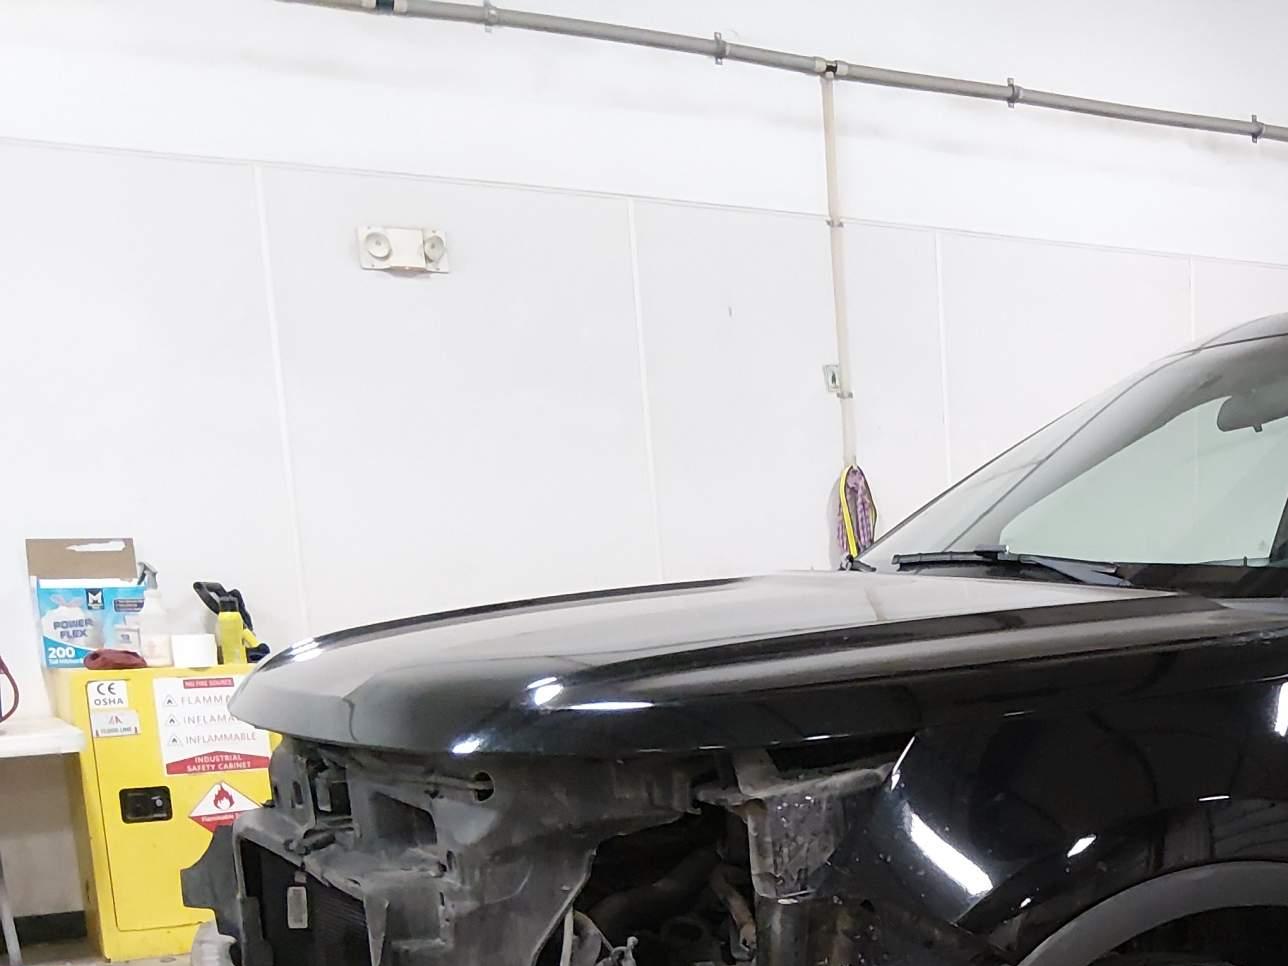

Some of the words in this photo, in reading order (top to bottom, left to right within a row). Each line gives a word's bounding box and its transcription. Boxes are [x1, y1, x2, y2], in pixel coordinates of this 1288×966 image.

[53, 619, 93, 630] POWER
[60, 629, 88, 639] FLEX
[48, 647, 75, 658] 200
[97, 682, 117, 695] CE
[94, 697, 124, 706] OSHA
[185, 732, 256, 744] INFLAMMABLE
[194, 754, 242, 763] INDUSTRIAL
[186, 763, 215, 772] SAFETY
[217, 760, 251, 770] CABINET
